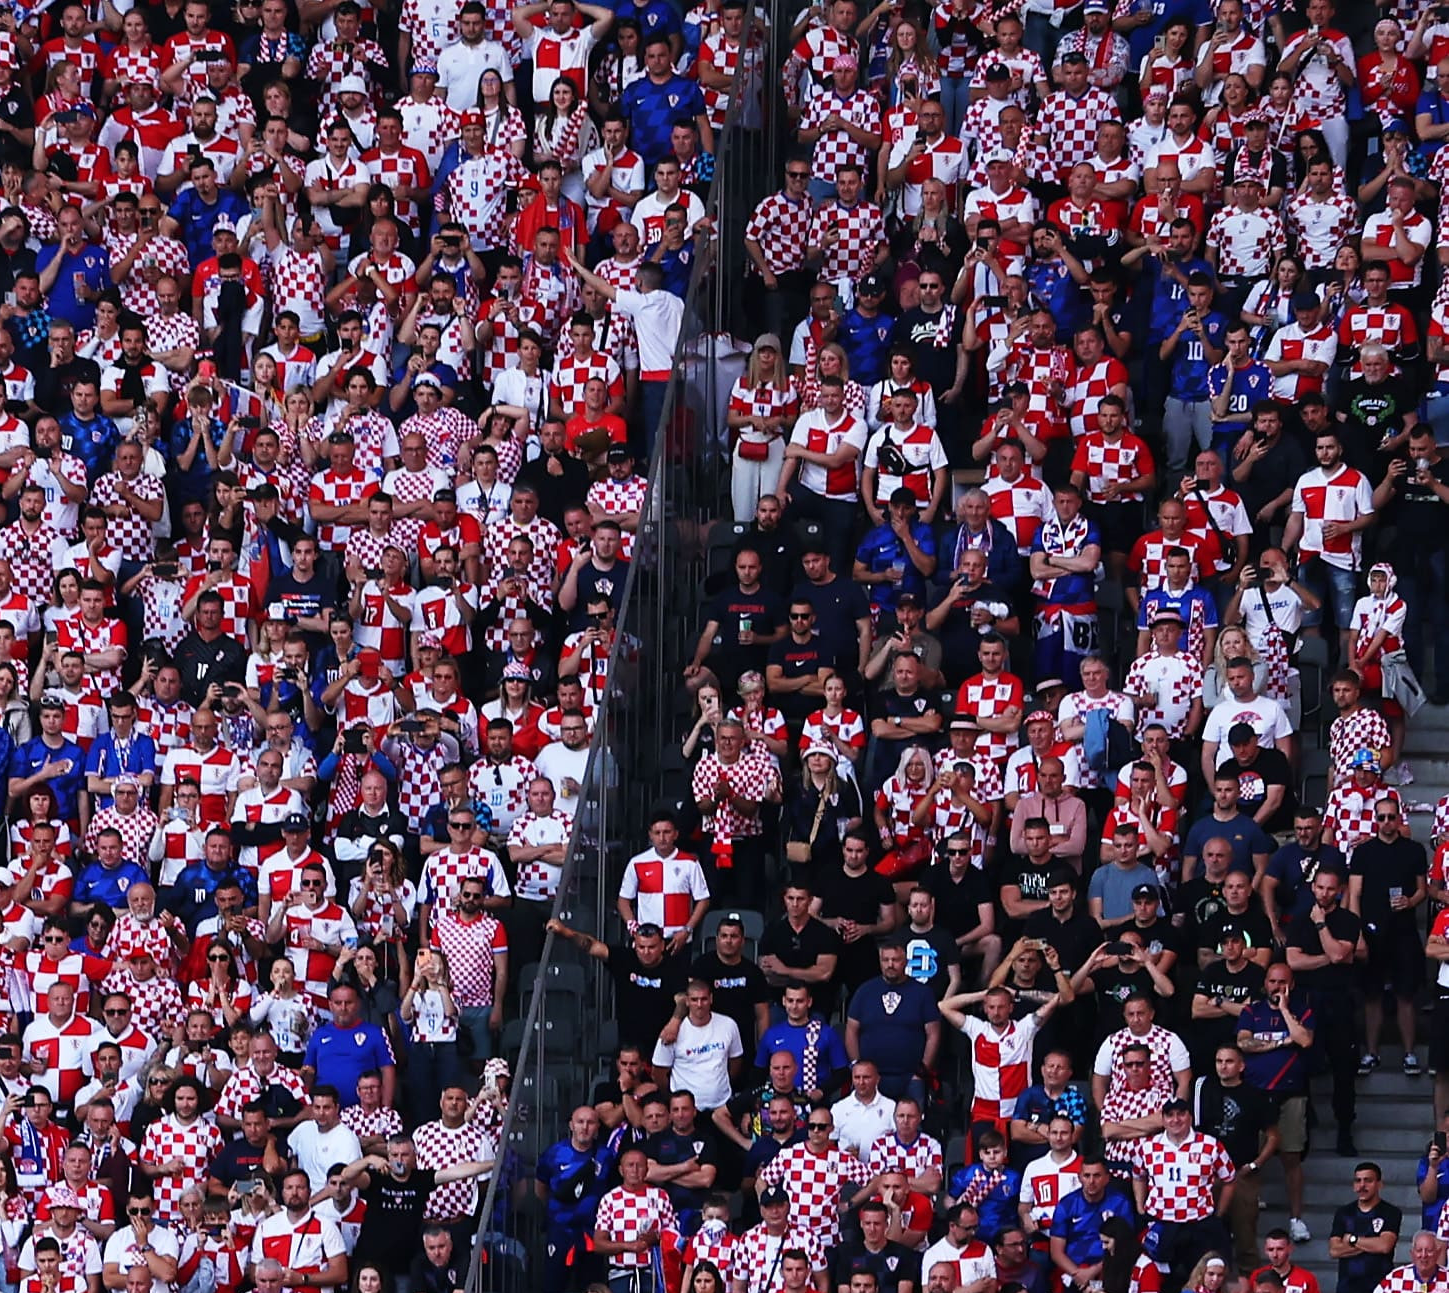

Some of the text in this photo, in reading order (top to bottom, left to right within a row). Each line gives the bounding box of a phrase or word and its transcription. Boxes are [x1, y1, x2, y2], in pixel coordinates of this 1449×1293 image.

[470, 181, 479, 197] 9
[1187, 342, 1203, 360] 10
[1230, 395, 1248, 411] 20
[1168, 1168, 1180, 1181] 11
[1038, 1183, 1051, 1201] 10
